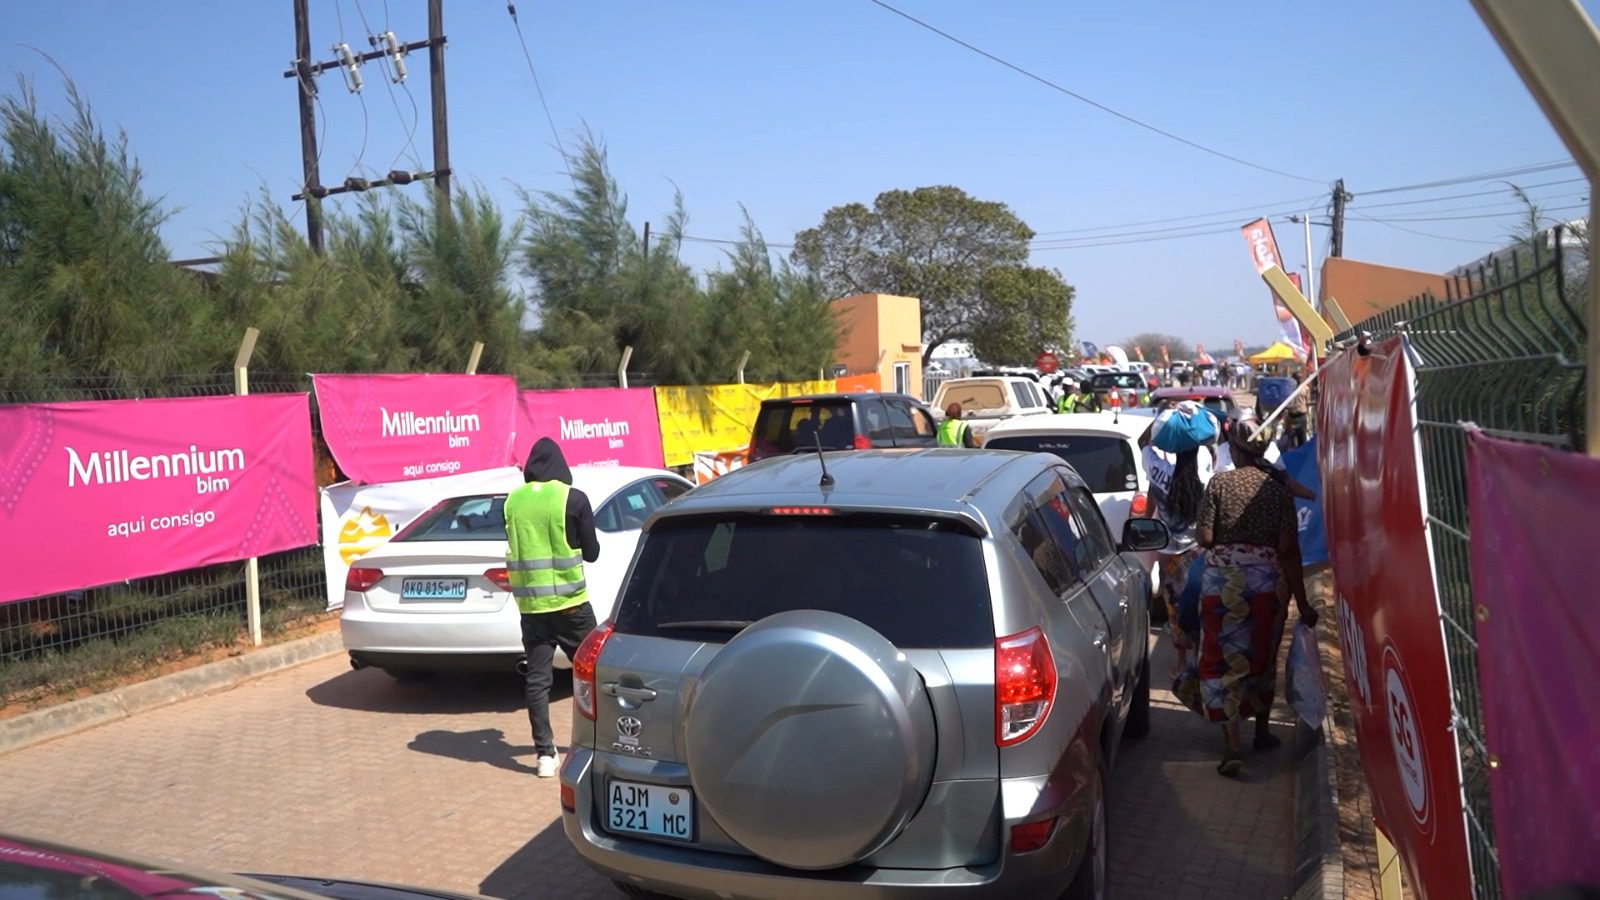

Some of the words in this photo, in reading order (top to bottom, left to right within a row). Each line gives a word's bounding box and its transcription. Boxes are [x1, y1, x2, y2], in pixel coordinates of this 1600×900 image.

[381, 408, 480, 437] Millennium
[560, 416, 629, 440] Millennium
[448, 434, 469, 448] bim
[608, 438, 624, 449] bim
[64, 445, 245, 487] Millennium
[403, 462, 424, 477] aqui
[425, 460, 461, 473] consigo
[196, 476, 230, 494] bim
[107, 516, 145, 538] aqui
[150, 509, 215, 527] consigo
[403, 582, 423, 595] AKQ
[425, 582, 443, 595] 815
[451, 582, 465, 595] MC
[612, 785, 649, 808] AJM
[612, 807, 649, 830] 321
[663, 813, 687, 835] MC
